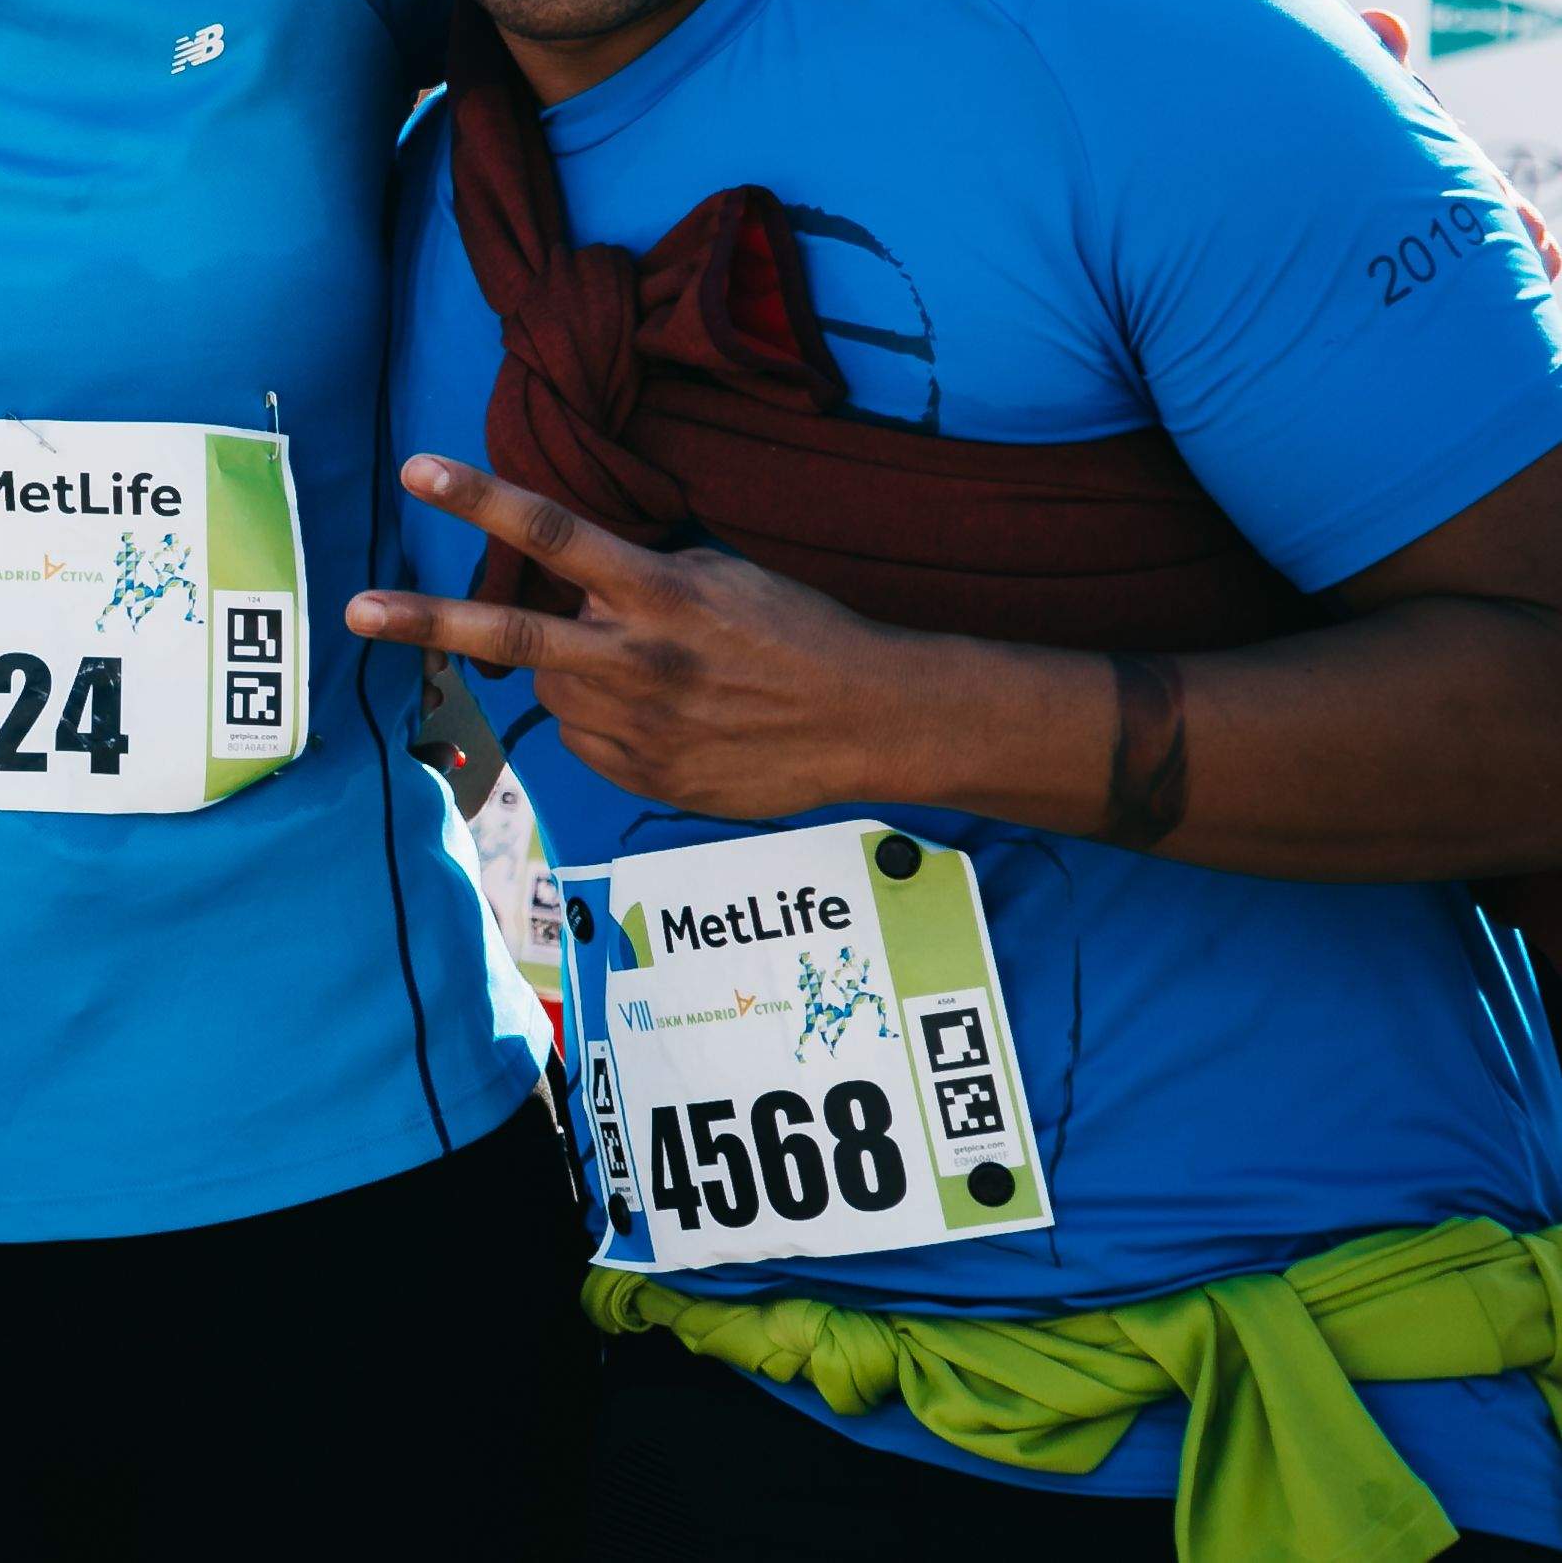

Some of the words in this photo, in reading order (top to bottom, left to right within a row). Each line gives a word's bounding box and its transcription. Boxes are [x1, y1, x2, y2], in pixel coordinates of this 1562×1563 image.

[1368, 202, 1486, 306] 2019
[660, 886, 852, 955] MetLife
[618, 1000, 655, 1032] VIII
[686, 1007, 737, 1025] MADRID
[649, 1079, 908, 1231] 4568
[954, 1141, 1006, 1156] getpica.com
